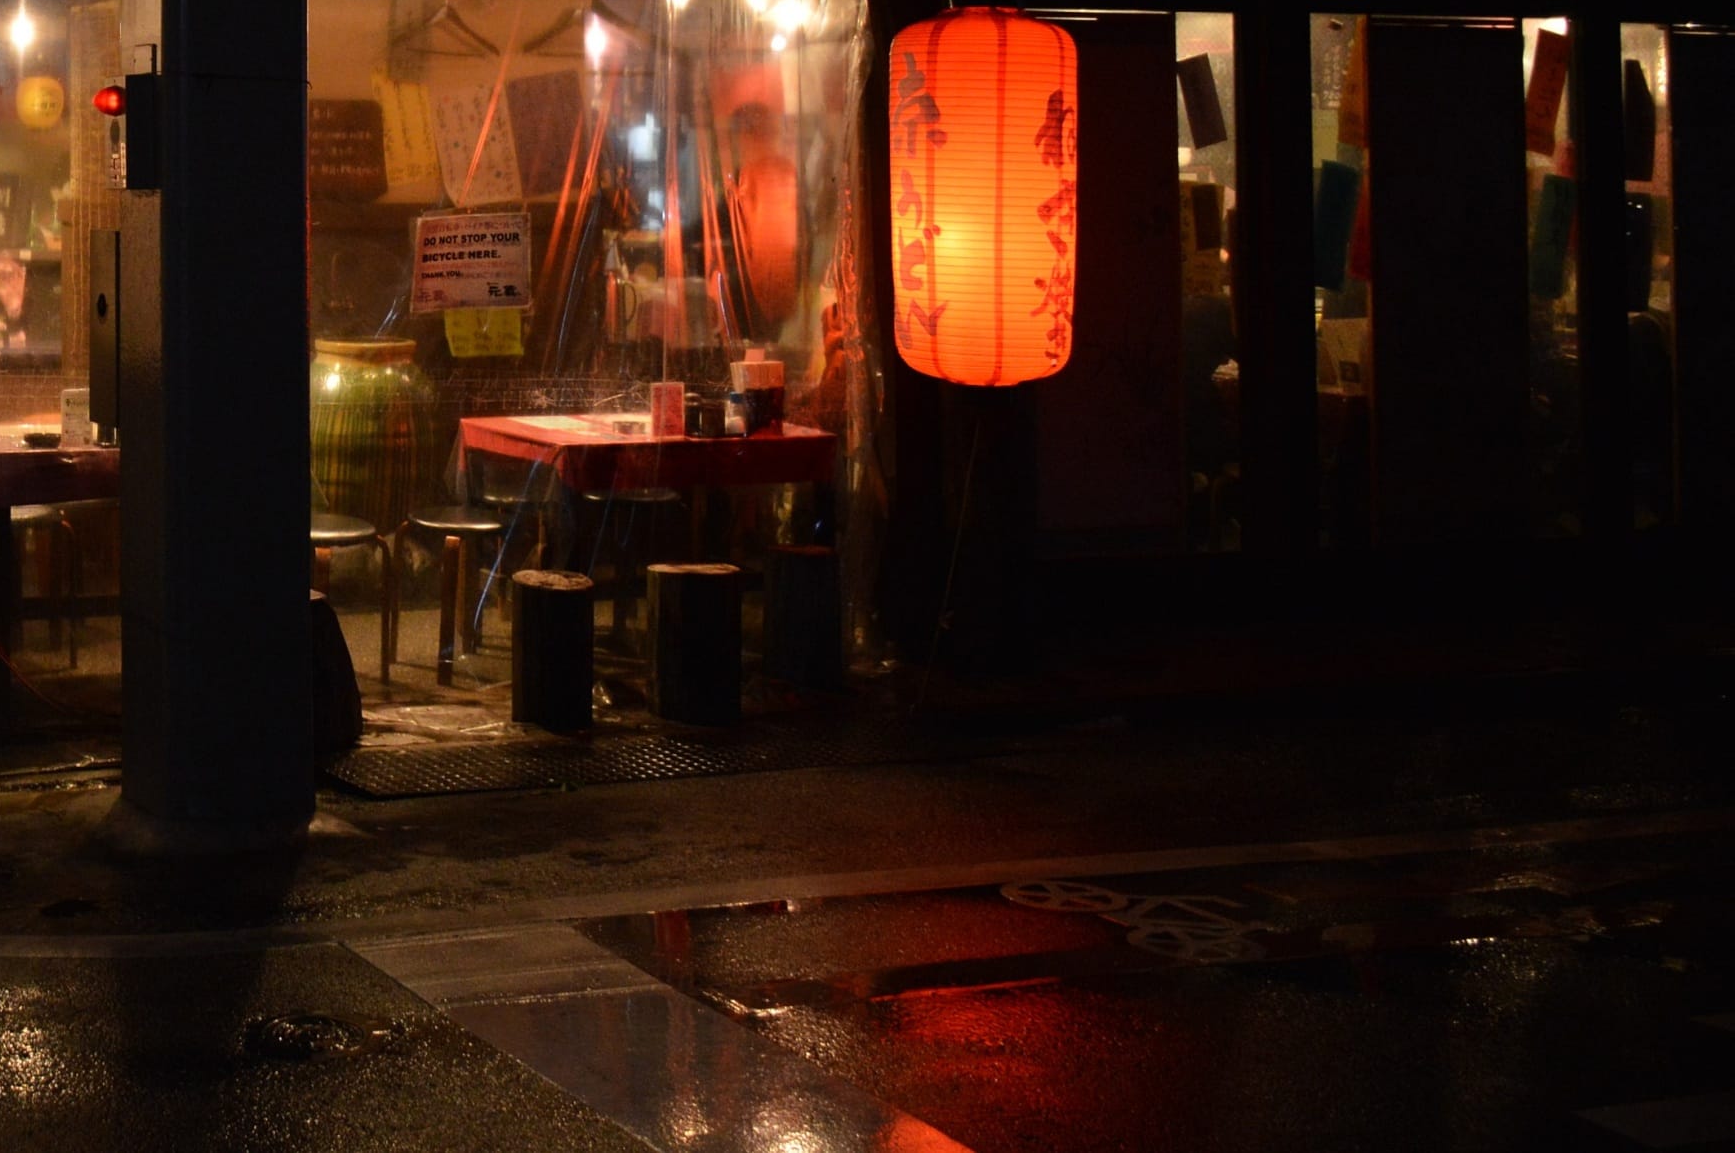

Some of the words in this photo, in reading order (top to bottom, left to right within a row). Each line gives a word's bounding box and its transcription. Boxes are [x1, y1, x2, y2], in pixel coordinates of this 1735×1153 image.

[423, 237, 437, 247] DO
[439, 235, 458, 245] NOT
[461, 234, 488, 244] STOP
[490, 232, 521, 243] YOUR
[422, 251, 465, 263] BICYCLE
